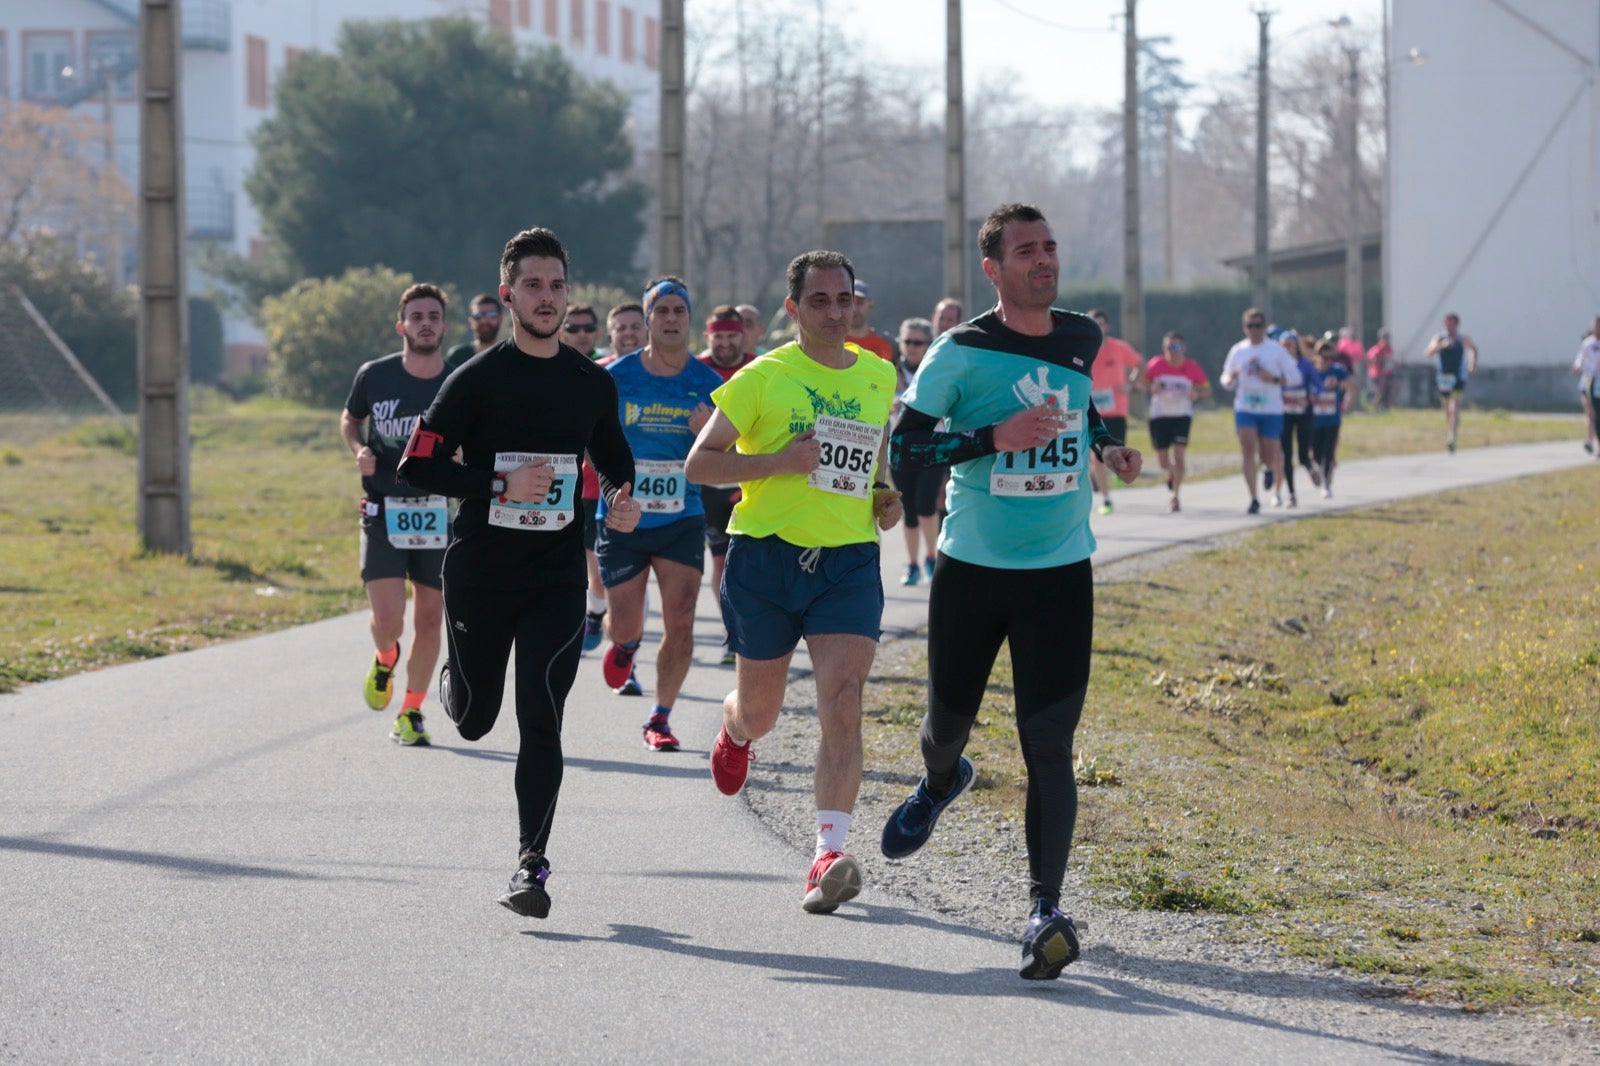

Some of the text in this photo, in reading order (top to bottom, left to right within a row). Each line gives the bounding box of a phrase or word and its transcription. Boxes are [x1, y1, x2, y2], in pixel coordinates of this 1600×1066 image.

[372, 398, 400, 421] SOY
[643, 403, 692, 419] olimpo
[789, 422, 804, 434] SAN
[833, 420, 847, 429] GRAN
[847, 422, 864, 433] PREMIO
[819, 441, 873, 474] 3058
[1003, 437, 1078, 469] 1145
[637, 476, 677, 496] 460
[397, 512, 437, 531] 802
